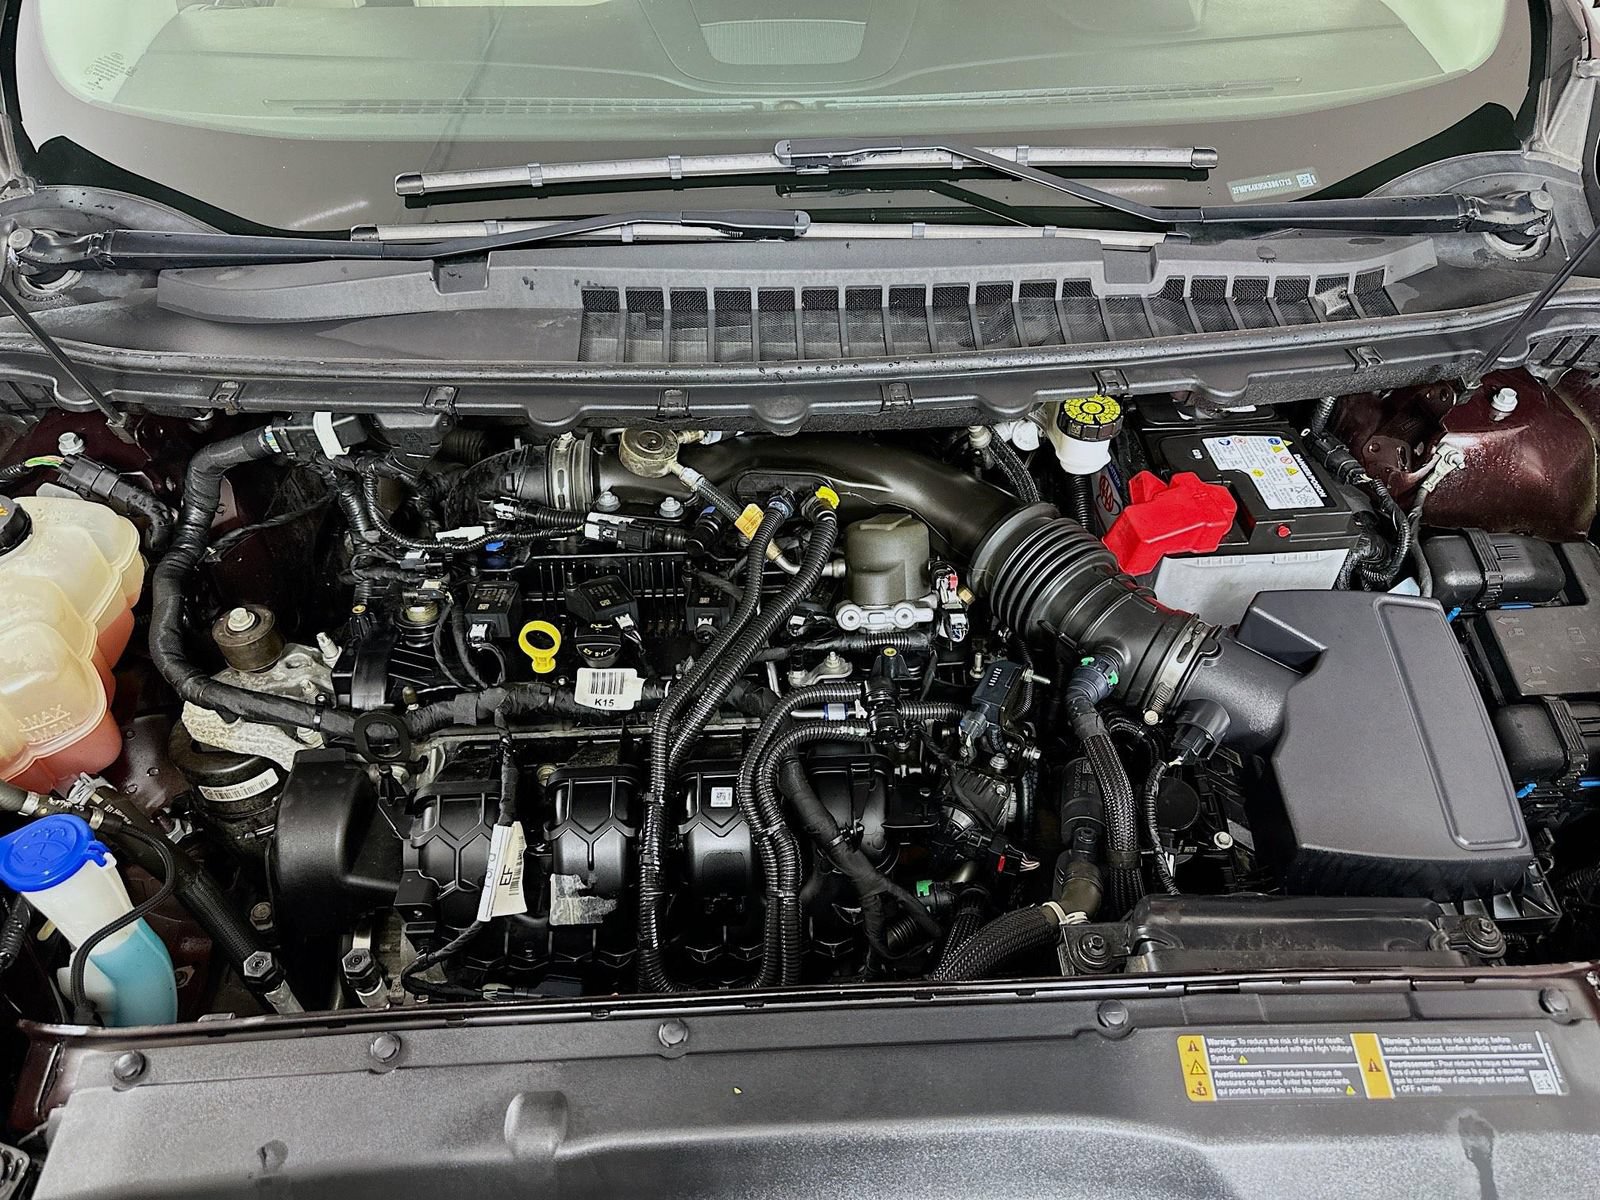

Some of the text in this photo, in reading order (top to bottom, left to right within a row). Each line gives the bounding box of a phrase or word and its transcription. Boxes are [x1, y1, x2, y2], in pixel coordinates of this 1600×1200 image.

[594, 698, 615, 707] K15
[499, 863, 514, 887] EF
[1206, 1038, 1237, 1047] Warning:
[1270, 1037, 1280, 1045] the
[1381, 1037, 1410, 1046] Warning:
[1227, 1046, 1265, 1055] components
[1214, 1070, 1262, 1079] Avertissement
[1266, 1070, 1282, 1078] Pour
[1215, 1078, 1246, 1086] blessures
[1217, 1087, 1227, 1096] qui
[1401, 1084, 1416, 1092] OFF
